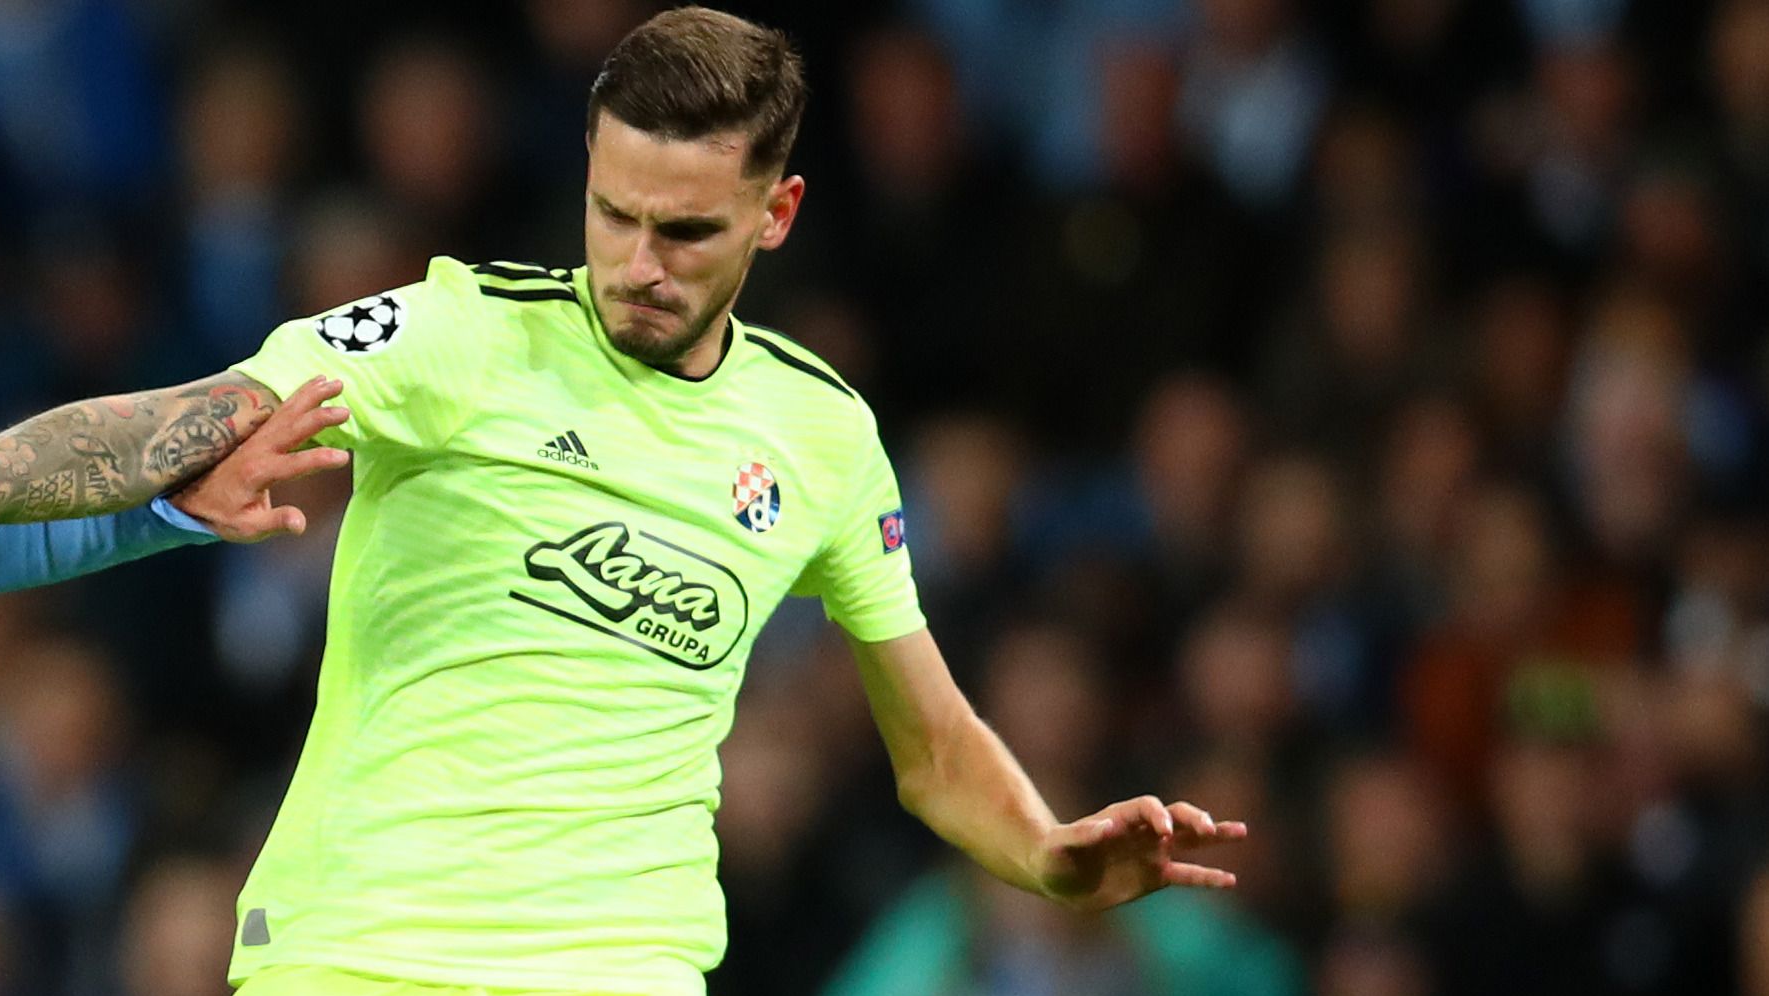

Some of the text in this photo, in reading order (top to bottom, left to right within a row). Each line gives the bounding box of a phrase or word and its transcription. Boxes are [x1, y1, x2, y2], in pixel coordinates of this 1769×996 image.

[537, 448, 599, 471] adidas
[524, 521, 720, 632] Lana
[635, 617, 710, 662] GRUPA
